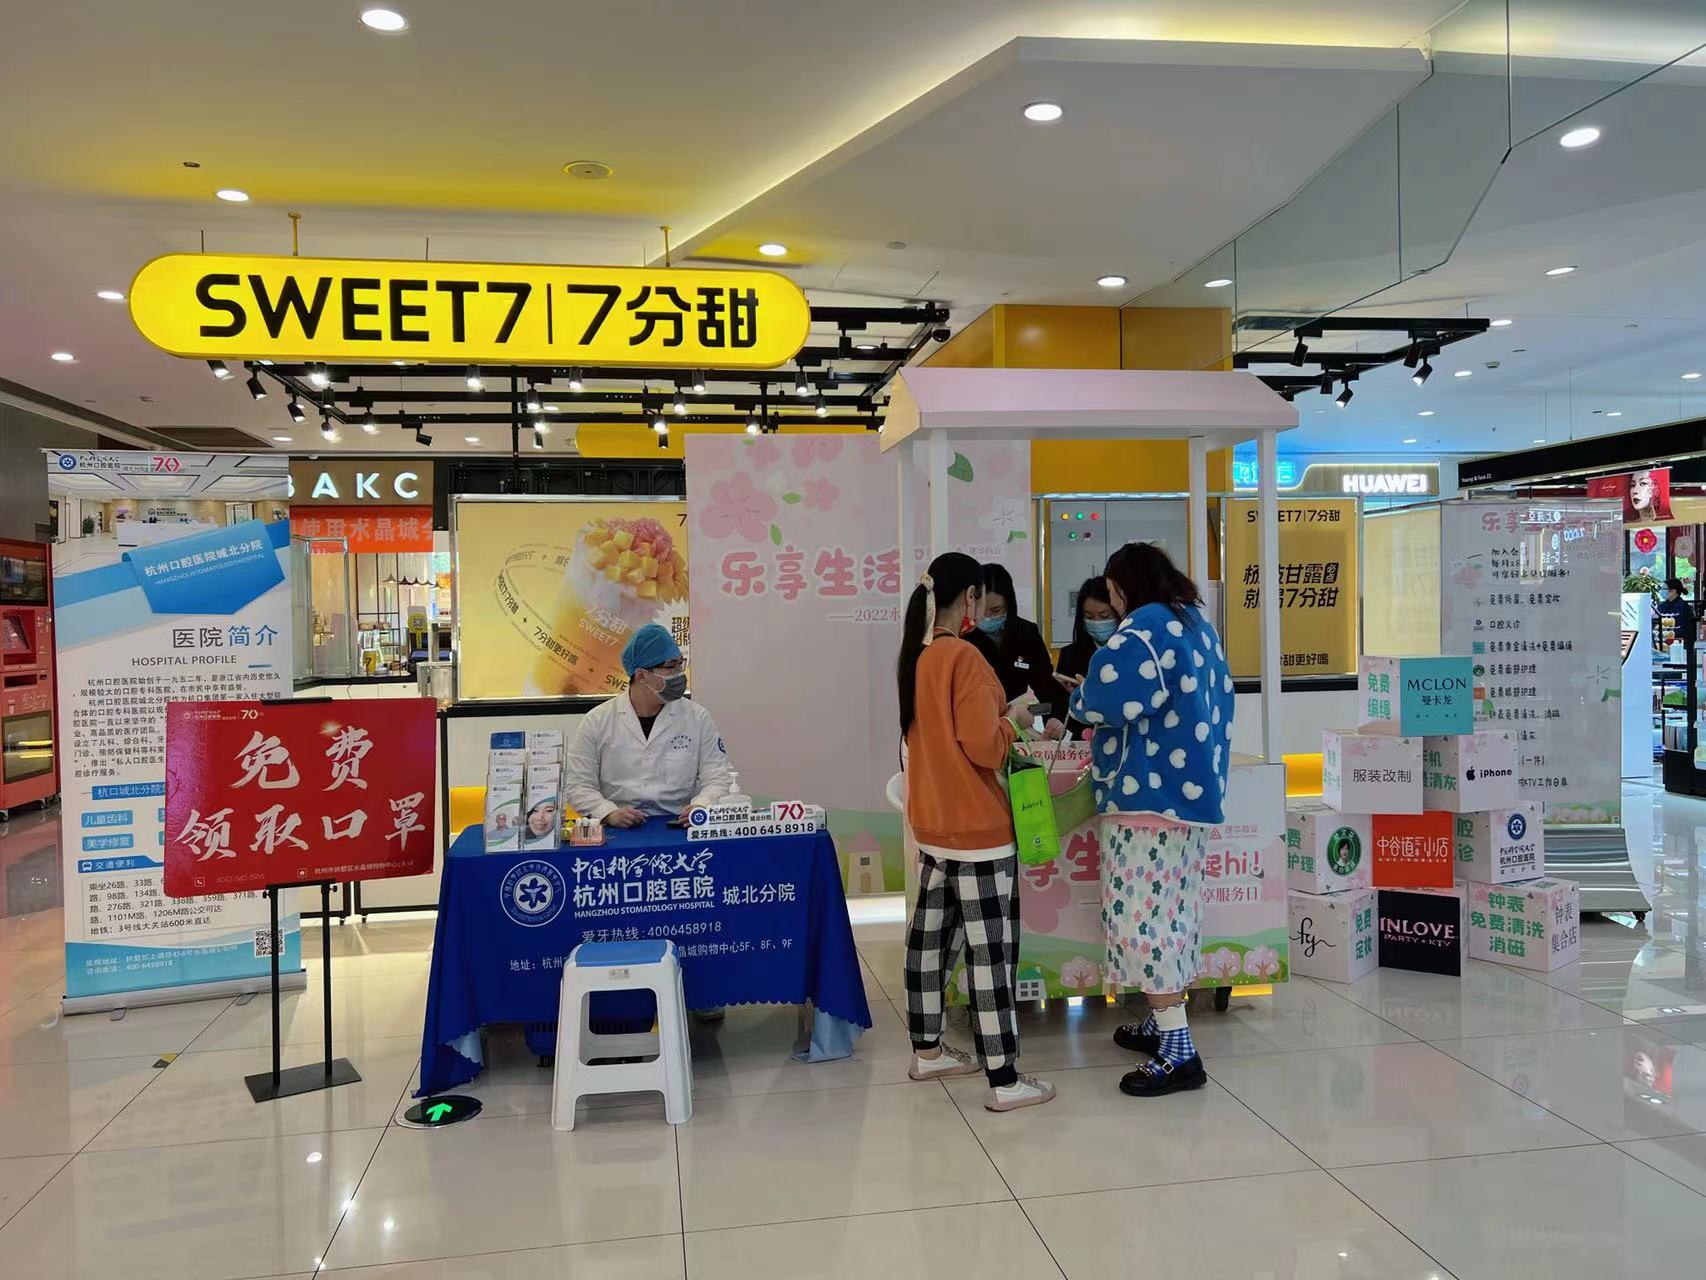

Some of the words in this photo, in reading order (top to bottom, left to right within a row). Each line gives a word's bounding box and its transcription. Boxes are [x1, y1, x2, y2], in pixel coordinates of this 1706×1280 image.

[196, 273, 532, 345] SWEET7
[568, 283, 760, 348] 7分甜
[1342, 473, 1428, 494] HUAWEI
[1308, 509, 1341, 522] 7分甜
[143, 538, 264, 577] 杭州口腔医院城北分院
[1243, 563, 1323, 585] 杨甘露
[172, 624, 279, 649] 医院简介
[132, 655, 188, 667] HOSPITAL
[191, 653, 237, 665] PROFILE
[1368, 673, 1390, 693] 免费
[1407, 677, 1467, 691] MCLON
[1421, 694, 1454, 706] 曼卡龙
[72, 704, 168, 717] 合体的口腔专科医院以现
[230, 725, 373, 792] 免费
[1352, 768, 1412, 784] 服装改制
[1479, 767, 1513, 779] iPhone
[97, 782, 165, 798] 杭口城北分院
[708, 814, 749, 823] 杭州口腔医院
[776, 803, 805, 821] 70
[173, 790, 426, 862] 领取口罩
[734, 826, 757, 837] 400
[760, 825, 782, 835] 645
[784, 822, 814, 834] 8918
[95, 858, 135, 870] 交通便利
[573, 875, 715, 908] 杭州口腔医院
[722, 881, 796, 906] 城北分院
[574, 907, 620, 919] HANGZHOU
[620, 902, 678, 916] STOMATOLOGY
[678, 900, 715, 911] HOSPITAL
[1488, 892, 1525, 913] 钟表
[1554, 901, 1574, 926] 钟表
[1379, 917, 1455, 940] INLOVE
[1470, 911, 1544, 939] 免费清洗
[1383, 934, 1419, 944] PARTY
[1429, 939, 1451, 947] KTV
[1489, 935, 1526, 958] 消磁
[1551, 926, 1578, 956] 集合店
